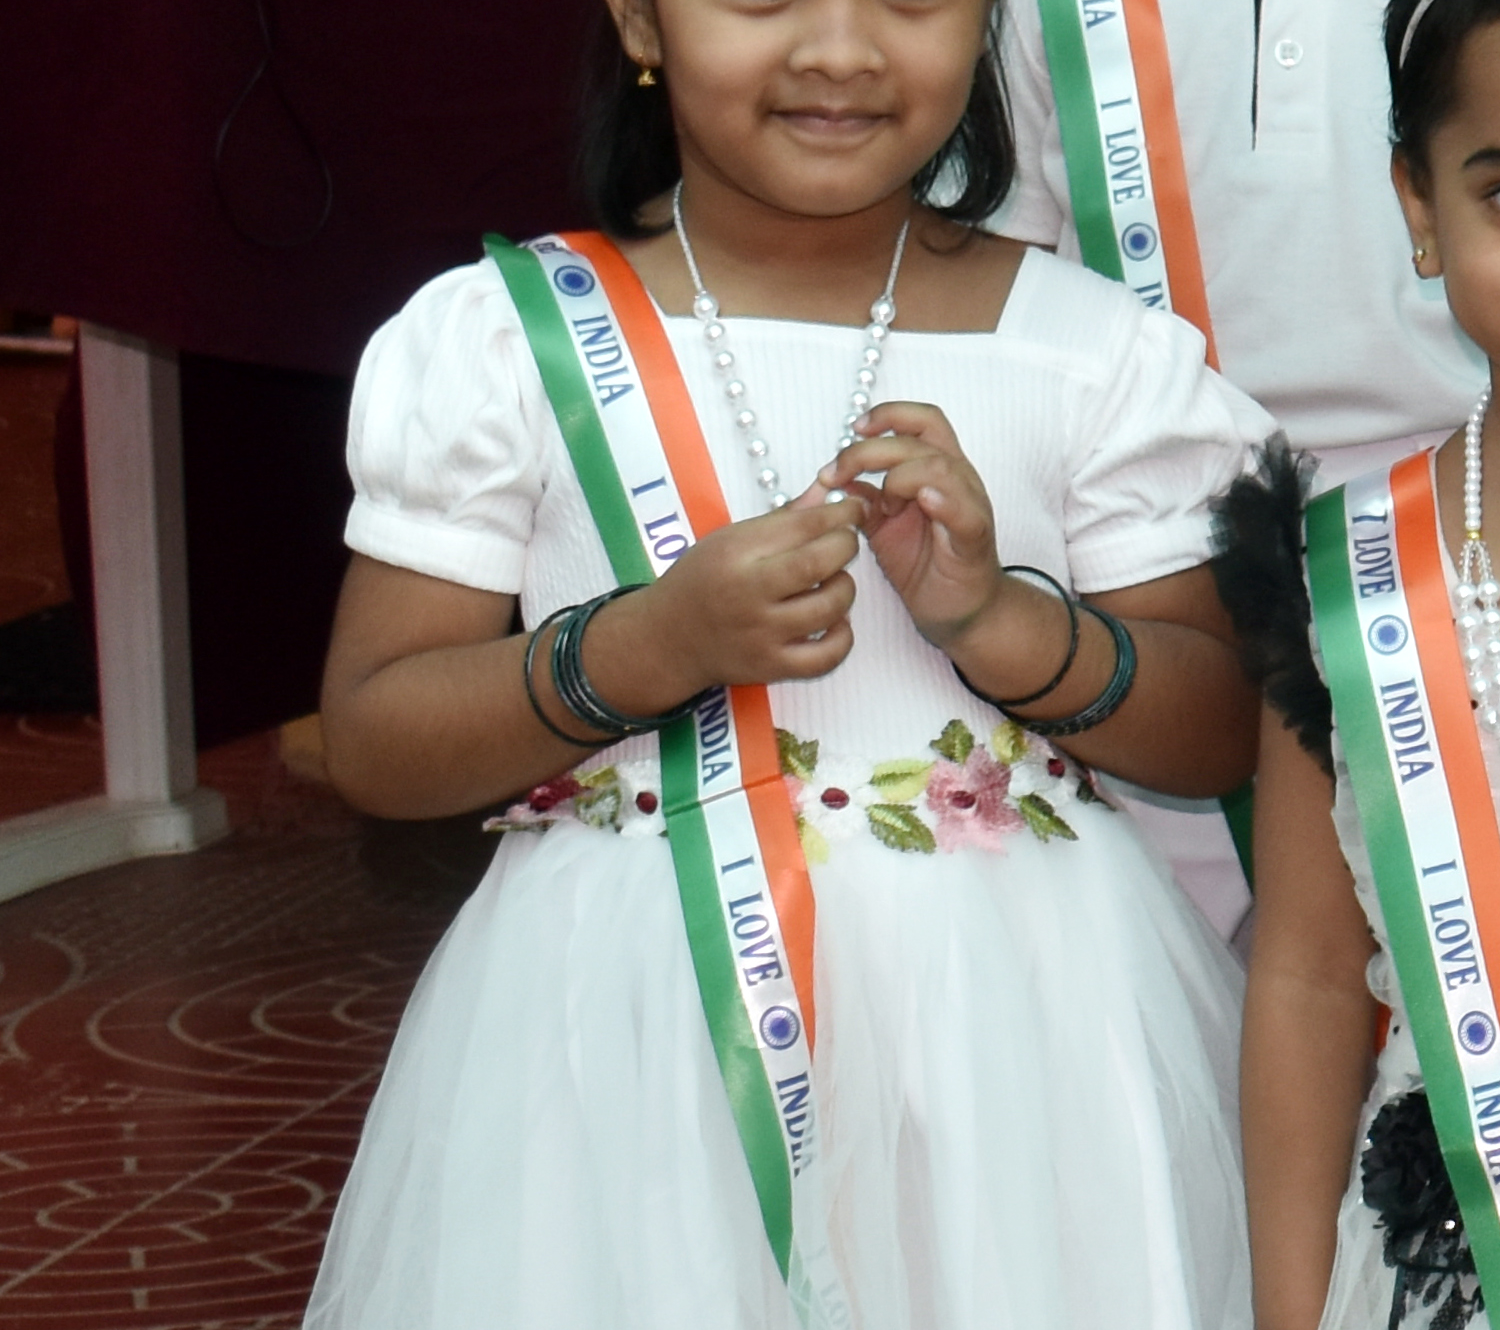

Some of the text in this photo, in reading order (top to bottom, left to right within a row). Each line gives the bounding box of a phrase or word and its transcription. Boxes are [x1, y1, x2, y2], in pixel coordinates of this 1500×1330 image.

[1101, 96, 1146, 205] I LOVE
[572, 314, 635, 408] INDIA
[631, 475, 667, 498] I
[643, 511, 689, 562] LO
[1352, 509, 1436, 786] I LOVE INDIA
[720, 855, 756, 876] I
[1422, 859, 1457, 879] I
[728, 891, 784, 987] LOVE
[1429, 895, 1482, 992] LOVE
